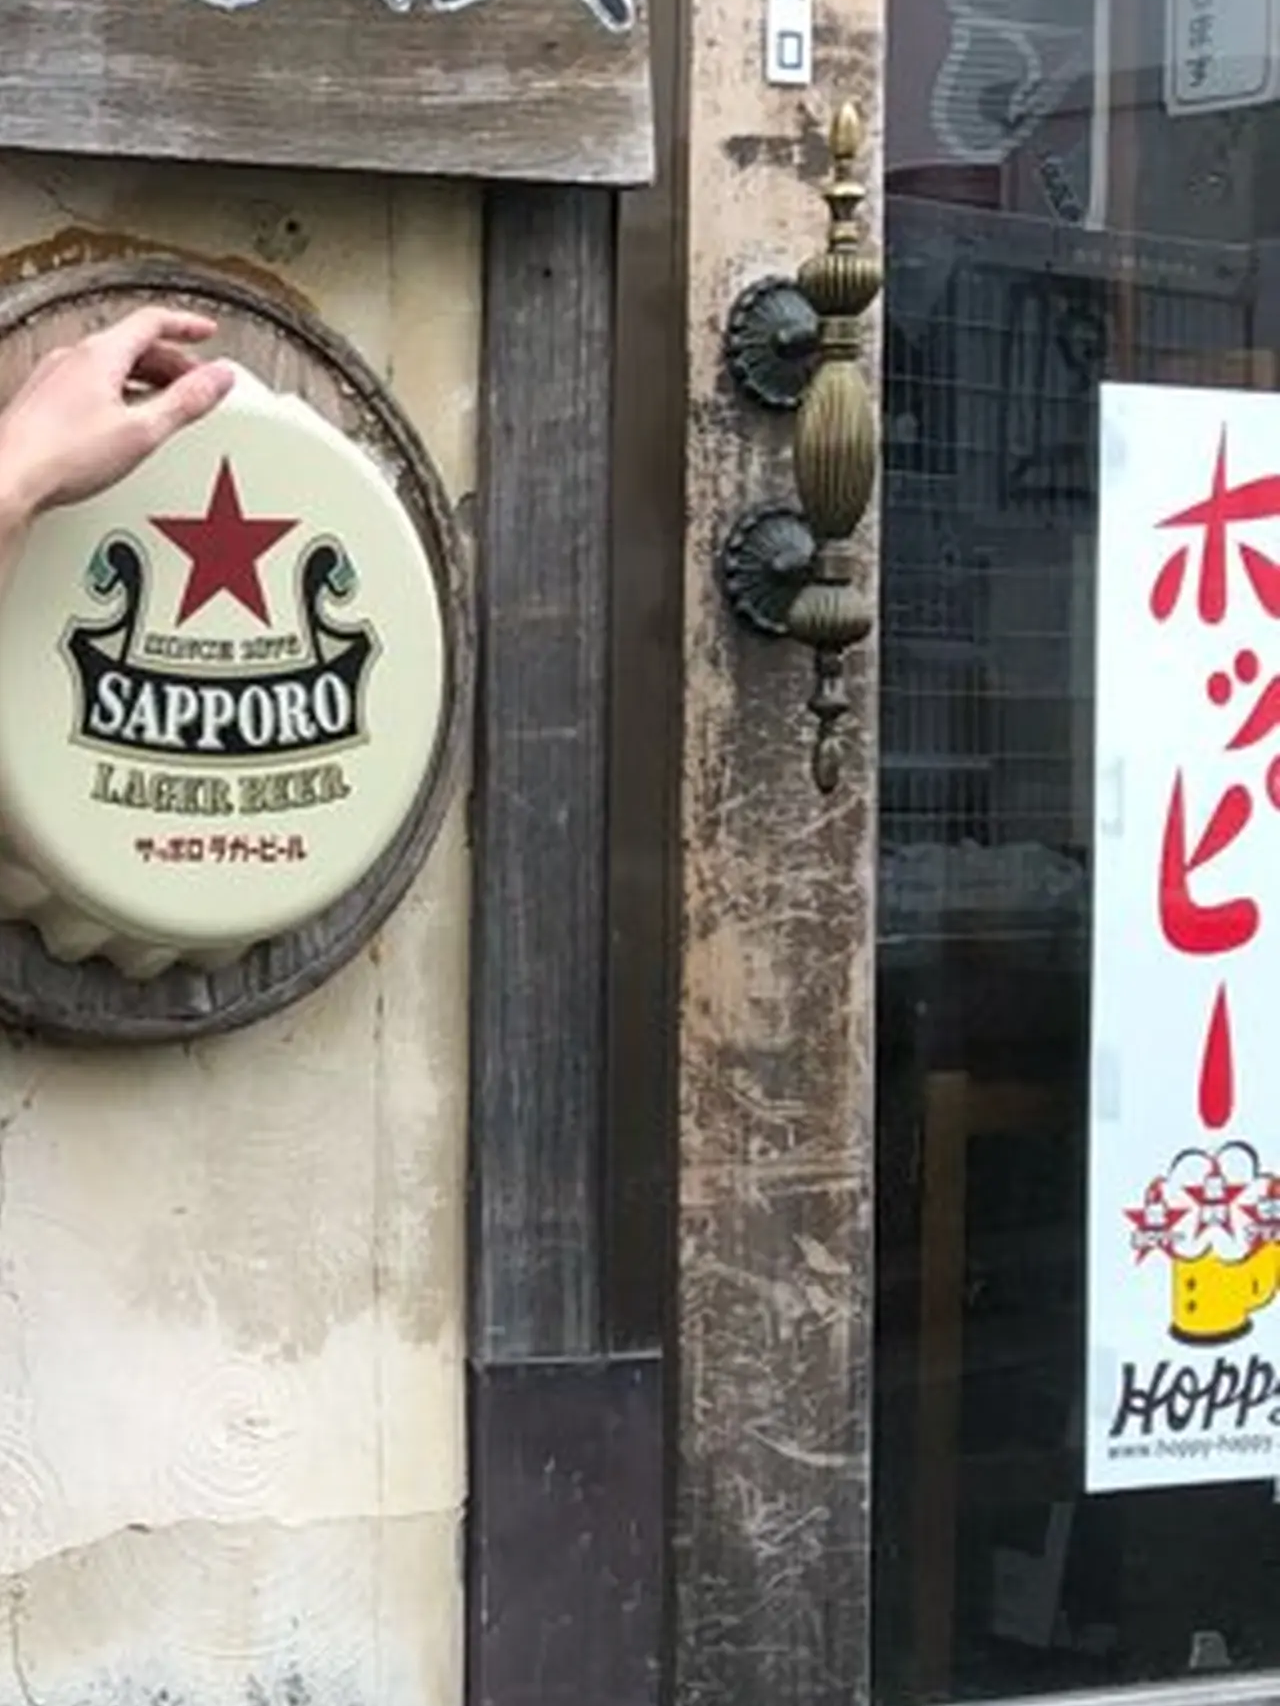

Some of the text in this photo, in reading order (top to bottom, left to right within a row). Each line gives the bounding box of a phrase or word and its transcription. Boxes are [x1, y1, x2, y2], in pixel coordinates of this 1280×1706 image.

[90, 670, 352, 750] SAPPORO
[90, 762, 352, 816] LAGER BEER
